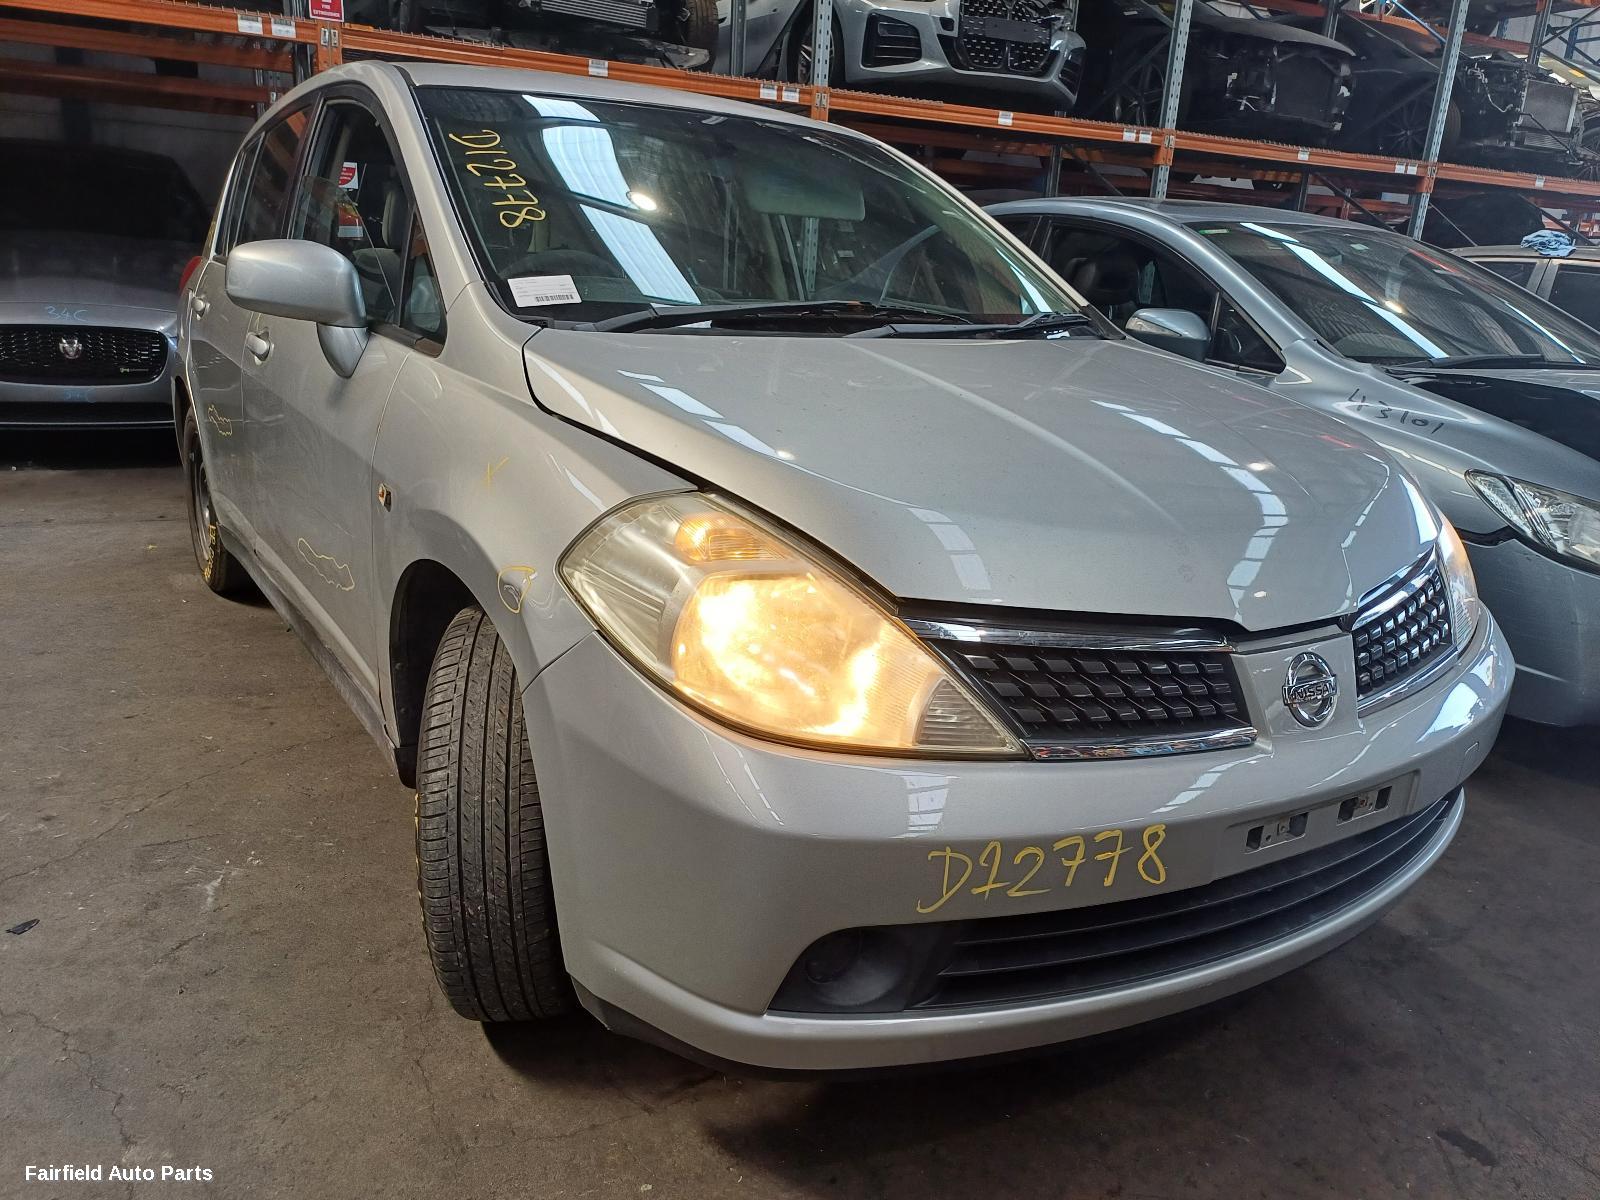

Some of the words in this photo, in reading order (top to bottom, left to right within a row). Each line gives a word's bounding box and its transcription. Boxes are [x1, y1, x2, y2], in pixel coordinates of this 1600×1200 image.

[448, 129, 546, 228] D12778
[1347, 388, 1445, 434] 43101
[916, 824, 1166, 913] D12778
